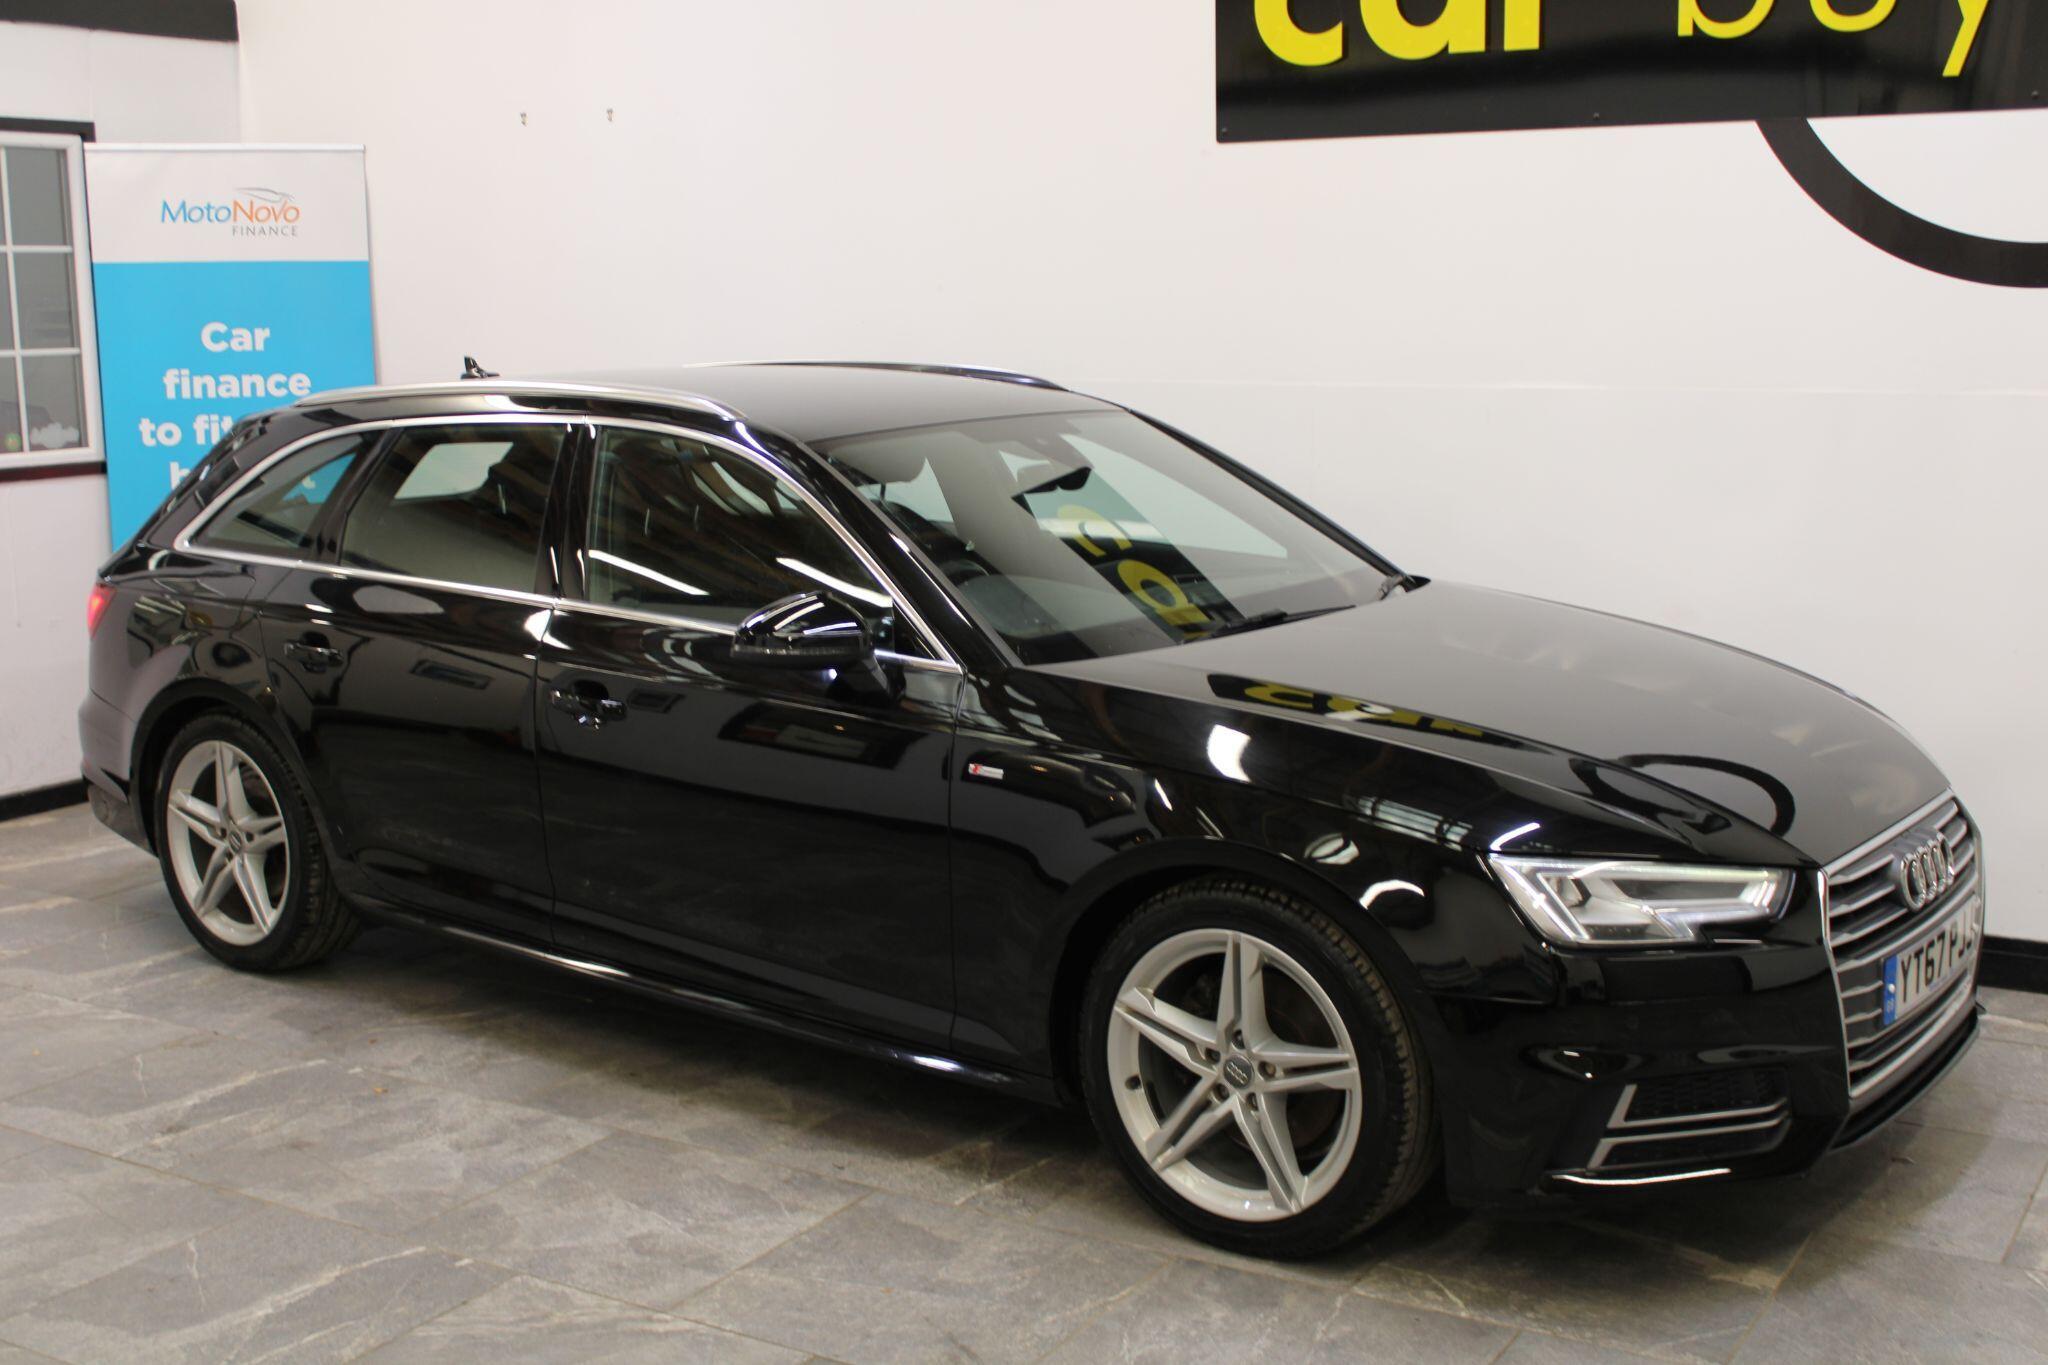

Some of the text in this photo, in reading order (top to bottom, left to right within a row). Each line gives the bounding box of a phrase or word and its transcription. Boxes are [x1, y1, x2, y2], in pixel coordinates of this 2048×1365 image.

[161, 199, 300, 224] MotoNovo
[232, 225, 298, 237] FINANCE
[200, 321, 271, 353] Car
[163, 368, 312, 400] finance
[139, 417, 182, 447] to
